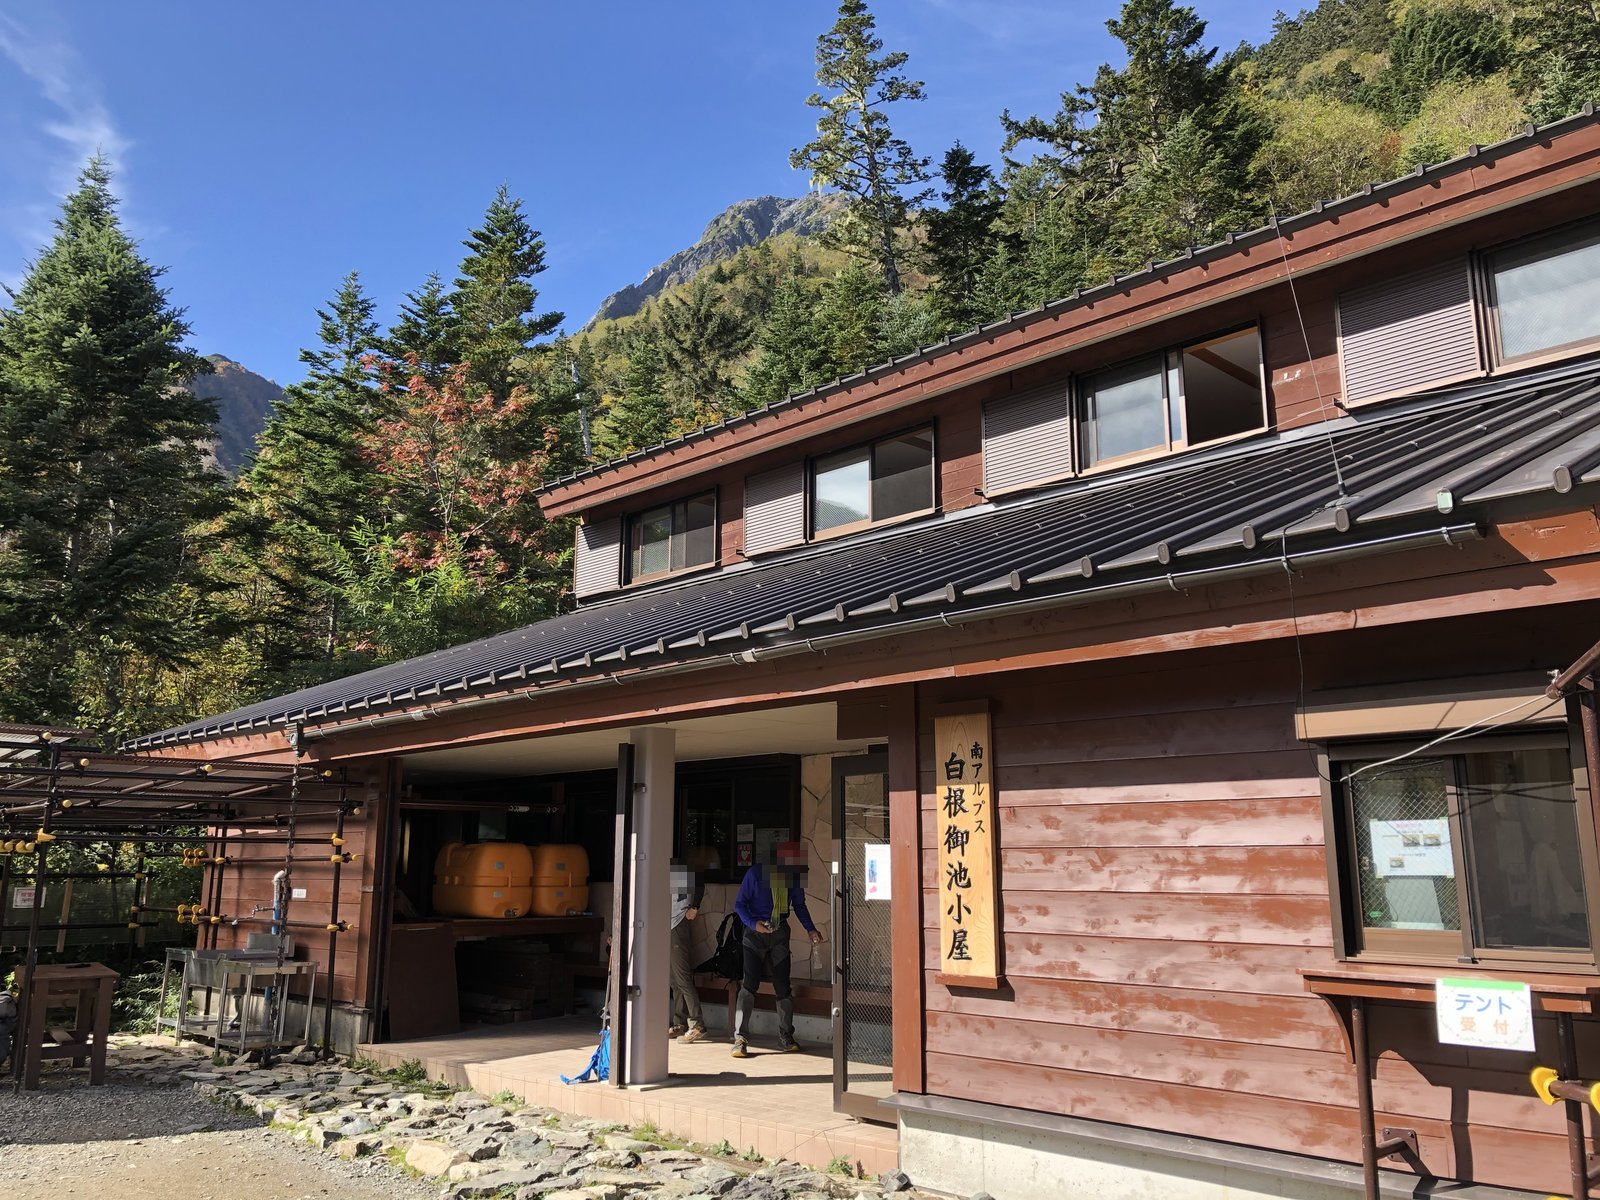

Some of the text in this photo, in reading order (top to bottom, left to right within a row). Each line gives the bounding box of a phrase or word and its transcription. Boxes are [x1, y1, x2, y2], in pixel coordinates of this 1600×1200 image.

[970, 741, 985, 834] 南アルプス
[943, 752, 972, 961] 白根御池小屋
[1455, 994, 1512, 1014] テント
[1460, 1016, 1509, 1036] 受付
